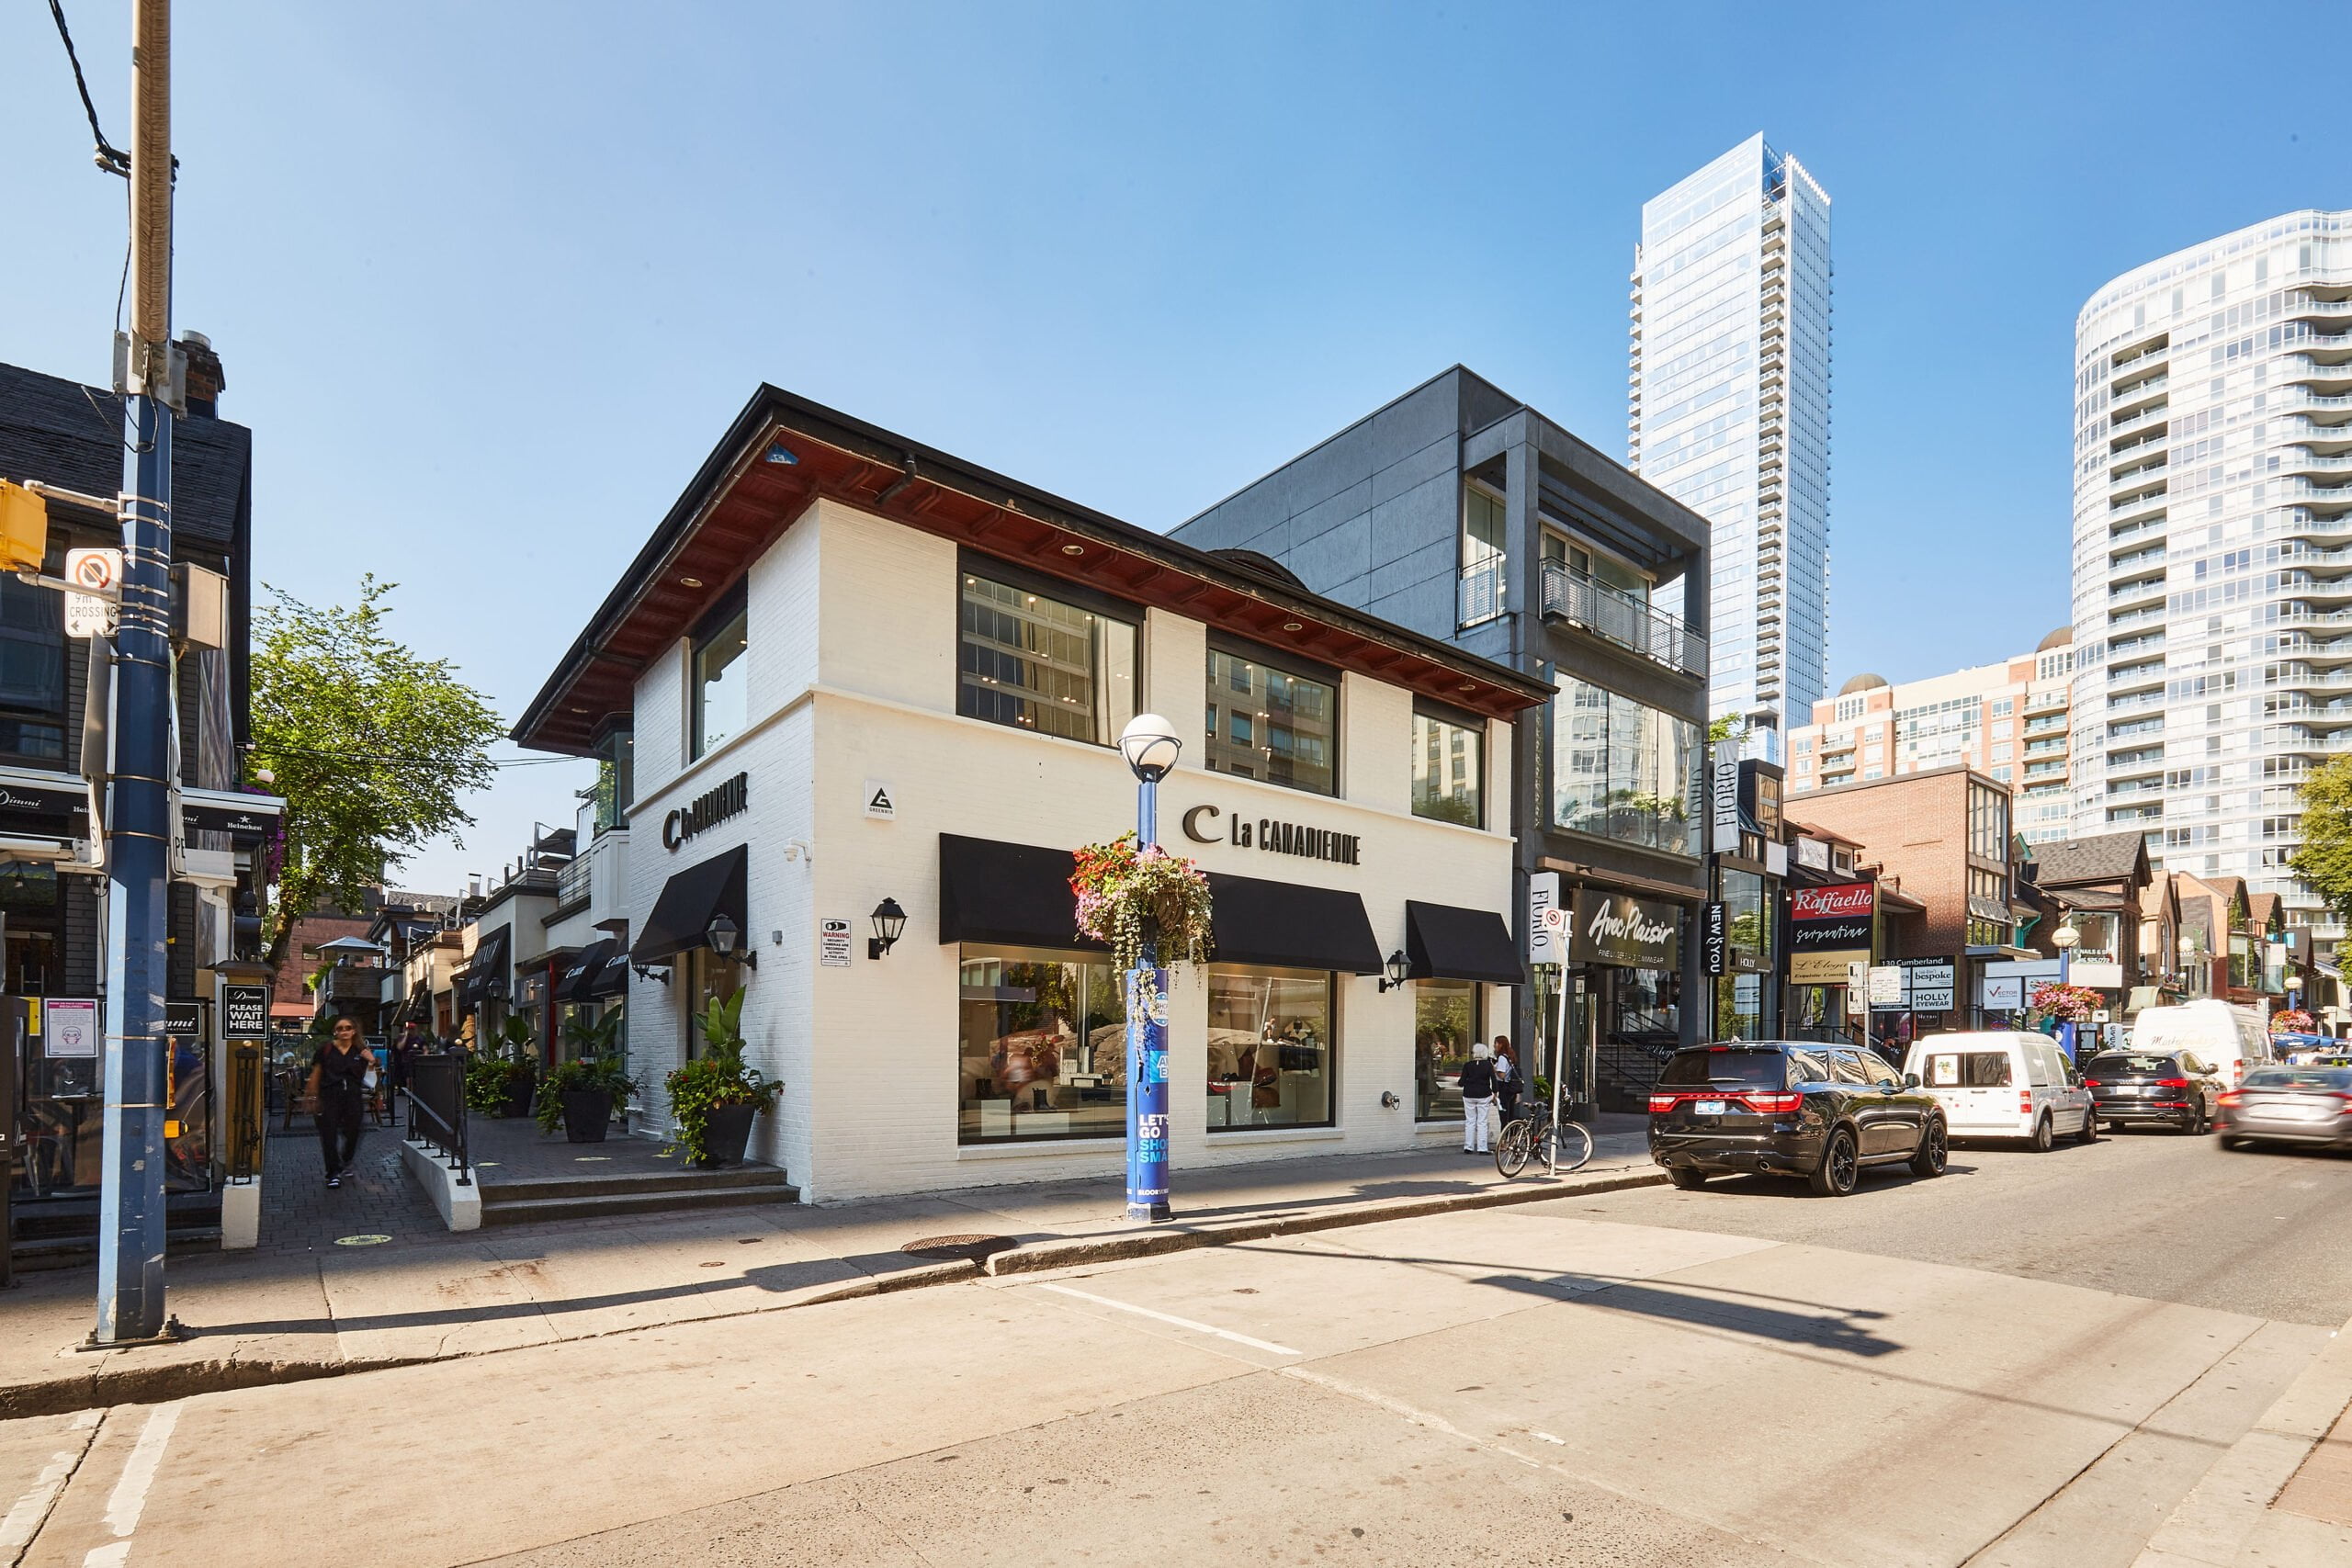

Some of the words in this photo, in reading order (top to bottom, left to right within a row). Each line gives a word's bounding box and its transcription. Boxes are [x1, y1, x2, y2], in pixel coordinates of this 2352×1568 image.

[69, 606, 117, 617] CROSSING
[868, 807, 893, 815] GREENWIN
[227, 822, 263, 831] Heineken
[1231, 813, 1252, 848] La
[1259, 818, 1362, 866] CANADIENNE
[1795, 889, 1872, 915] Raffaello
[1588, 898, 1625, 946] Avec
[1623, 905, 1675, 945] Plaisir
[1711, 905, 1722, 935] NEW
[1710, 945, 1720, 973] YOU
[1740, 957, 1756, 968] HOLLY
[1896, 957, 1943, 967] Cumberland
[1915, 970, 1951, 982] bespoke
[1916, 993, 1949, 1001] HOLLY
[230, 1011, 264, 1021] WAIT
[229, 1020, 264, 1030] HERE
[1139, 1126, 1160, 1139] GO
